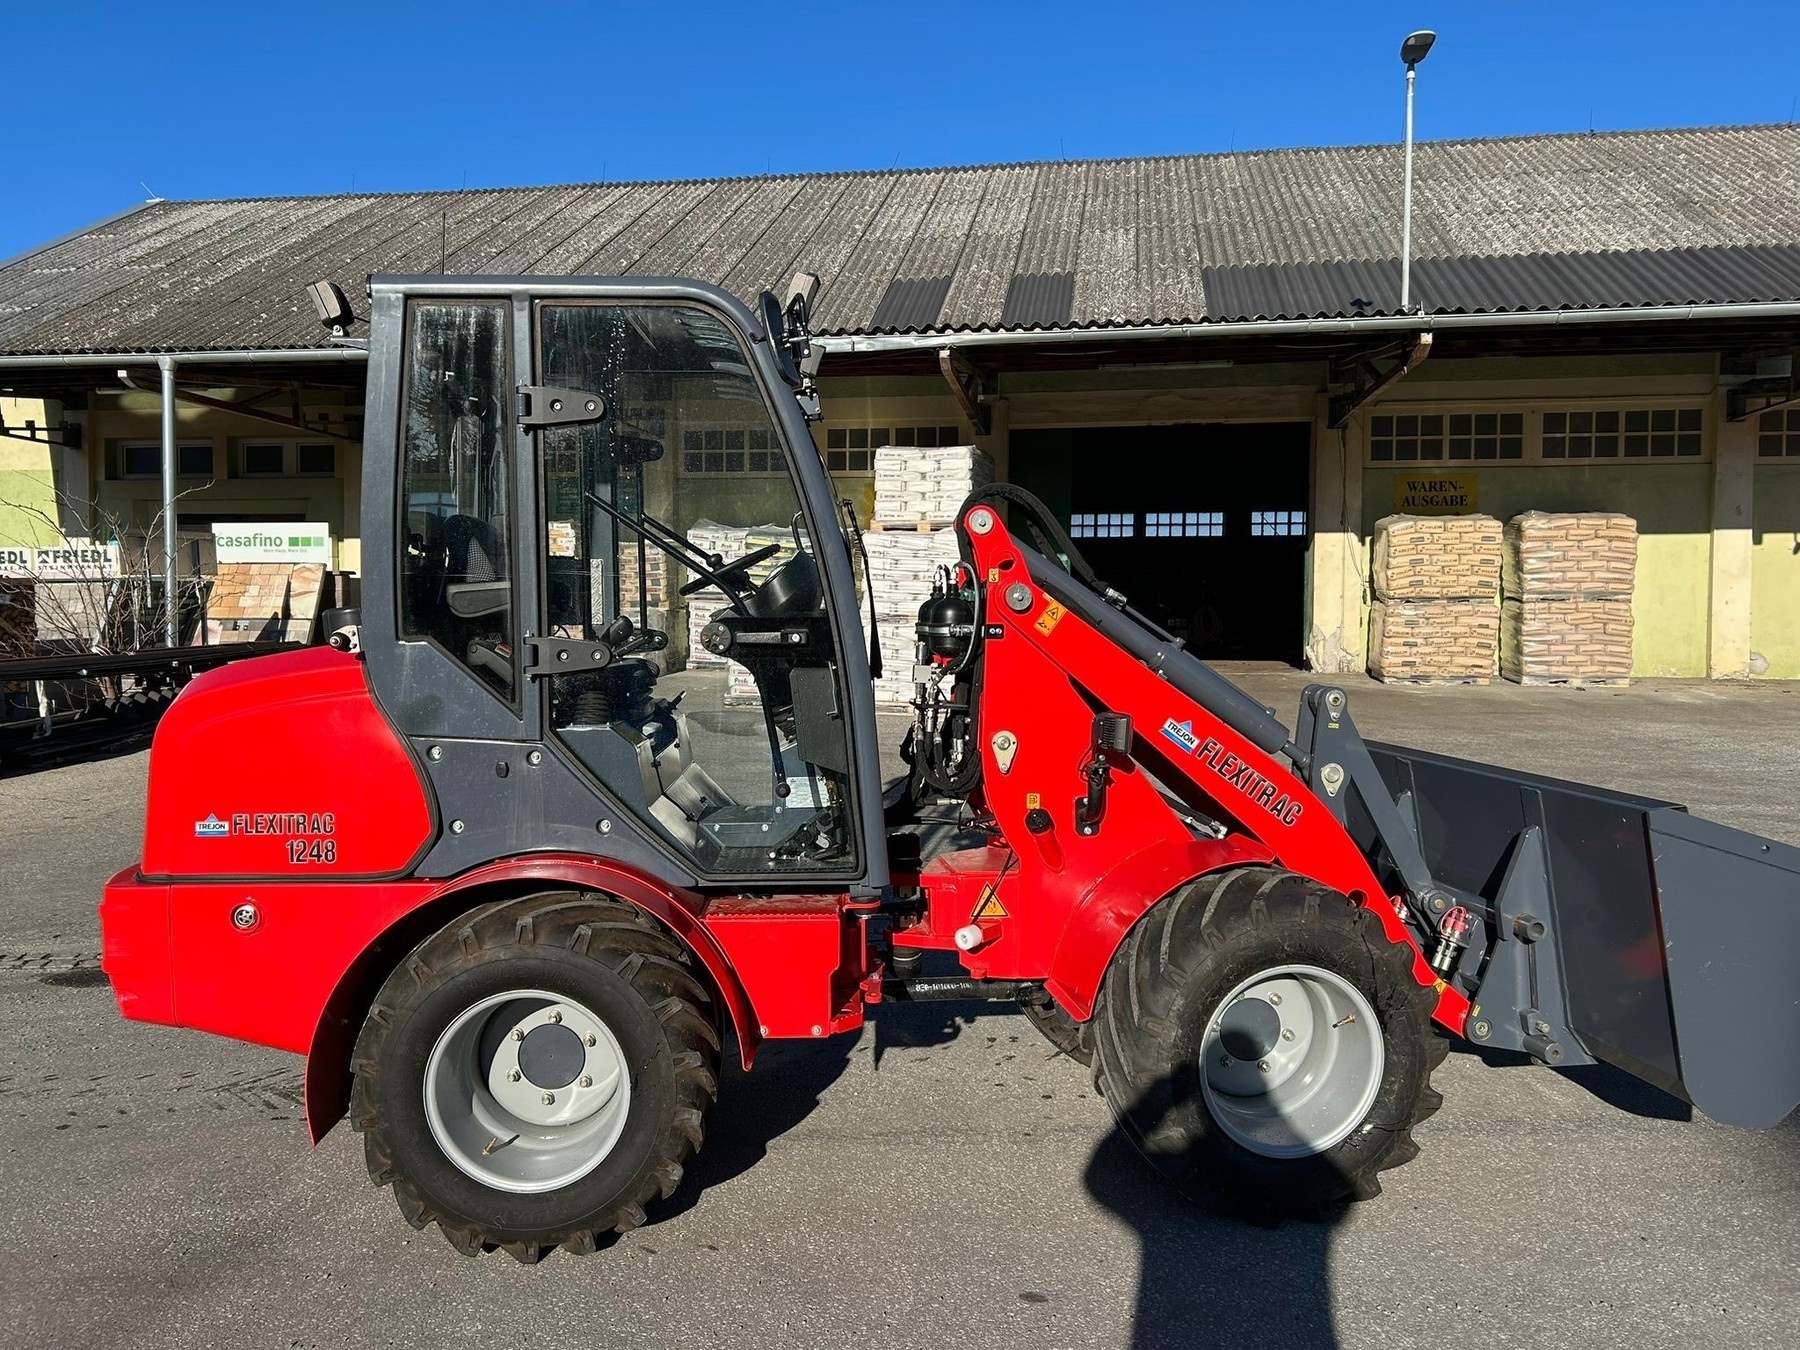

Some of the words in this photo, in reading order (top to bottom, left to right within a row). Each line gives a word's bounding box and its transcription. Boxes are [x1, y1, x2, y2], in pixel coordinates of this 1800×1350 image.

[1406, 480, 1464, 492] WAREN-
[1402, 494, 1468, 507] AUSGABE
[216, 533, 283, 547] casafino
[53, 549, 112, 563] FRIEDL
[1167, 721, 1196, 746] TREJON
[1195, 736, 1303, 827] FLEXITRAC
[233, 813, 334, 835] FLEXITRAC
[286, 839, 336, 864] 1248
